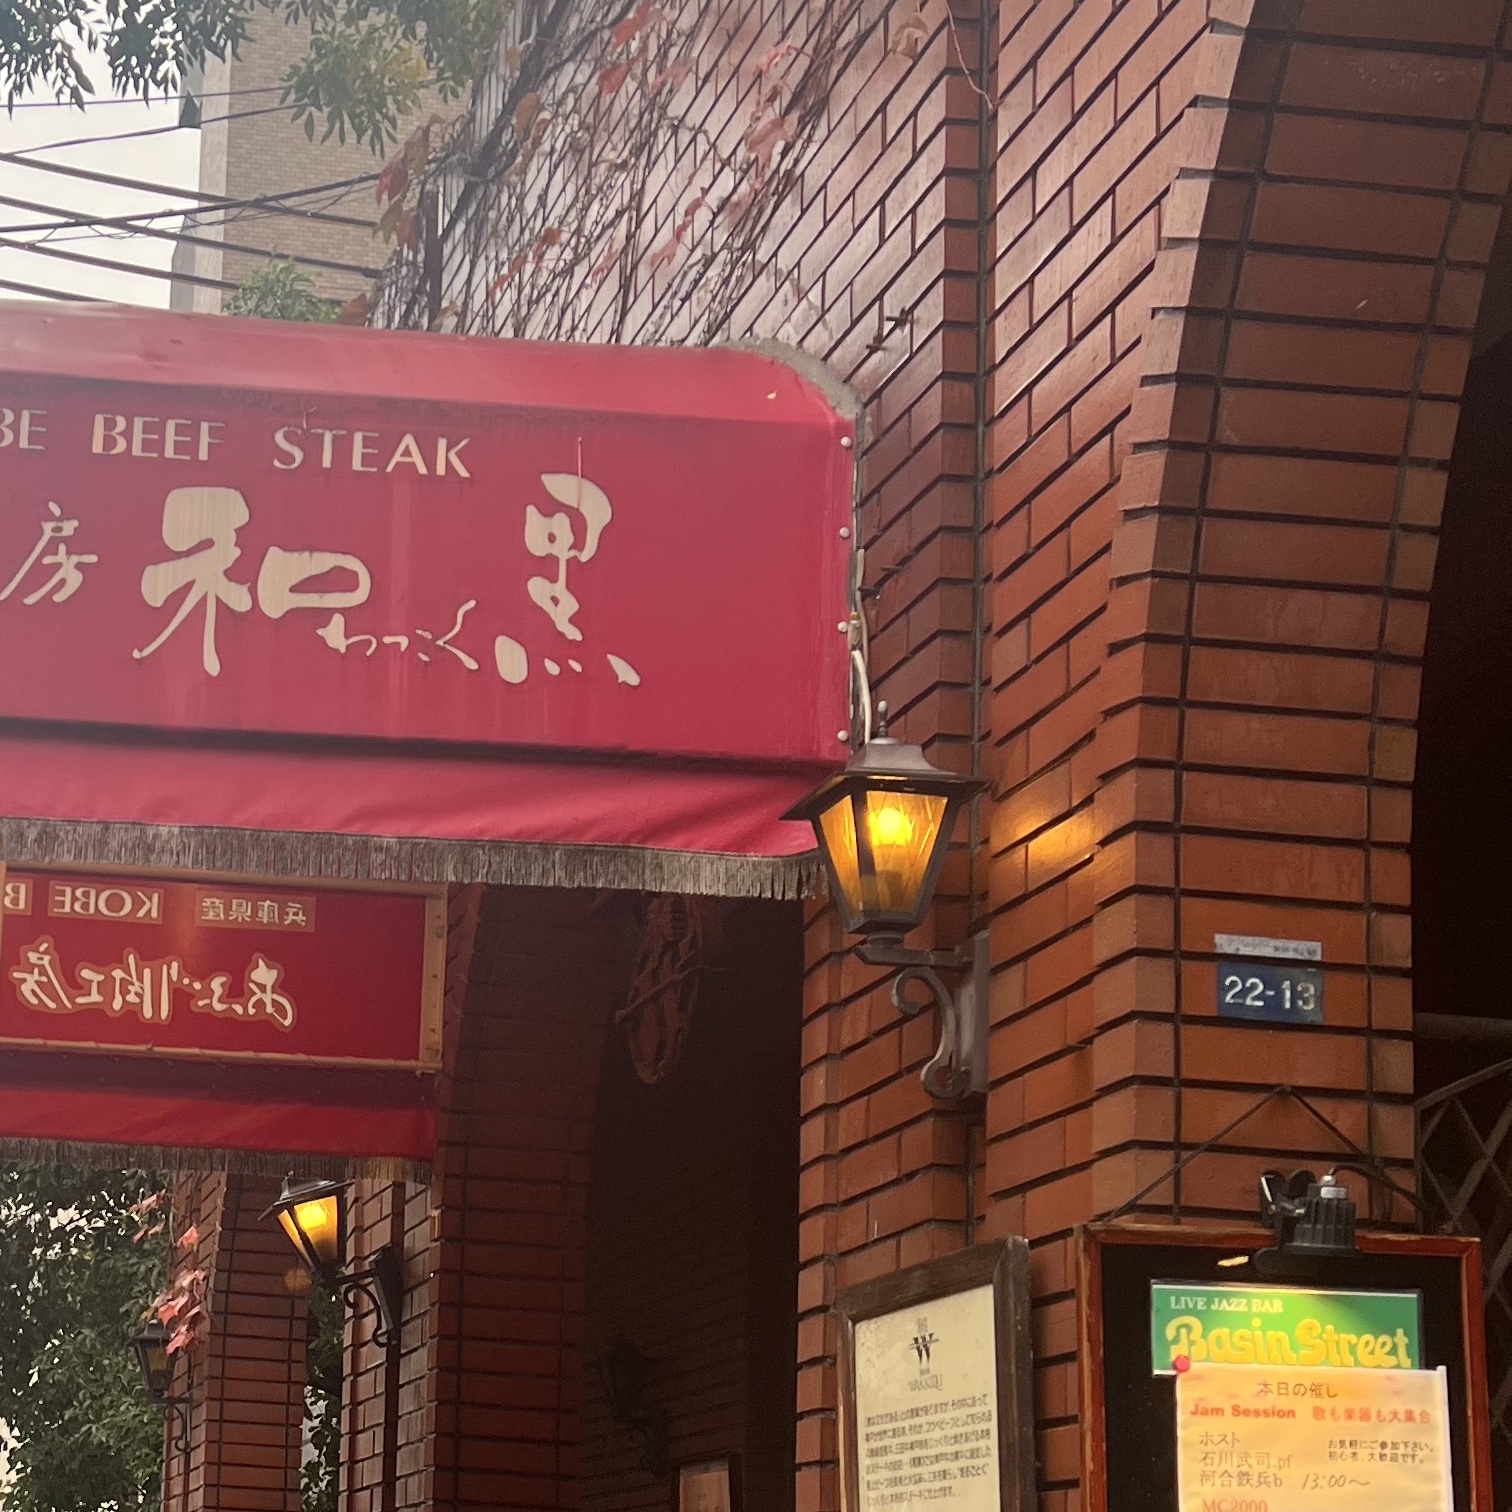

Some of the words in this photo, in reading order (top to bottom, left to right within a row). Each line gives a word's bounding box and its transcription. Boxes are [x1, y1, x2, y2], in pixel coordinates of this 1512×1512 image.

[91, 413, 227, 462] BEEF
[273, 425, 472, 478] STEAK
[1224, 975, 1316, 1011] 22-13
[1170, 1296, 1207, 1310] LIVE
[1210, 1298, 1248, 1312] JAZZ
[1252, 1299, 1283, 1313] BAR
[1165, 1315, 1296, 1365] Basin
[1295, 1318, 1412, 1369] Street
[1257, 1381, 1338, 1398] 本日の催し
[1190, 1404, 1225, 1417] Jam
[1231, 1405, 1296, 1419] Session
[1311, 1406, 1431, 1424] 歌も楽器も大集合
[1199, 1432, 1240, 1448] ホスト
